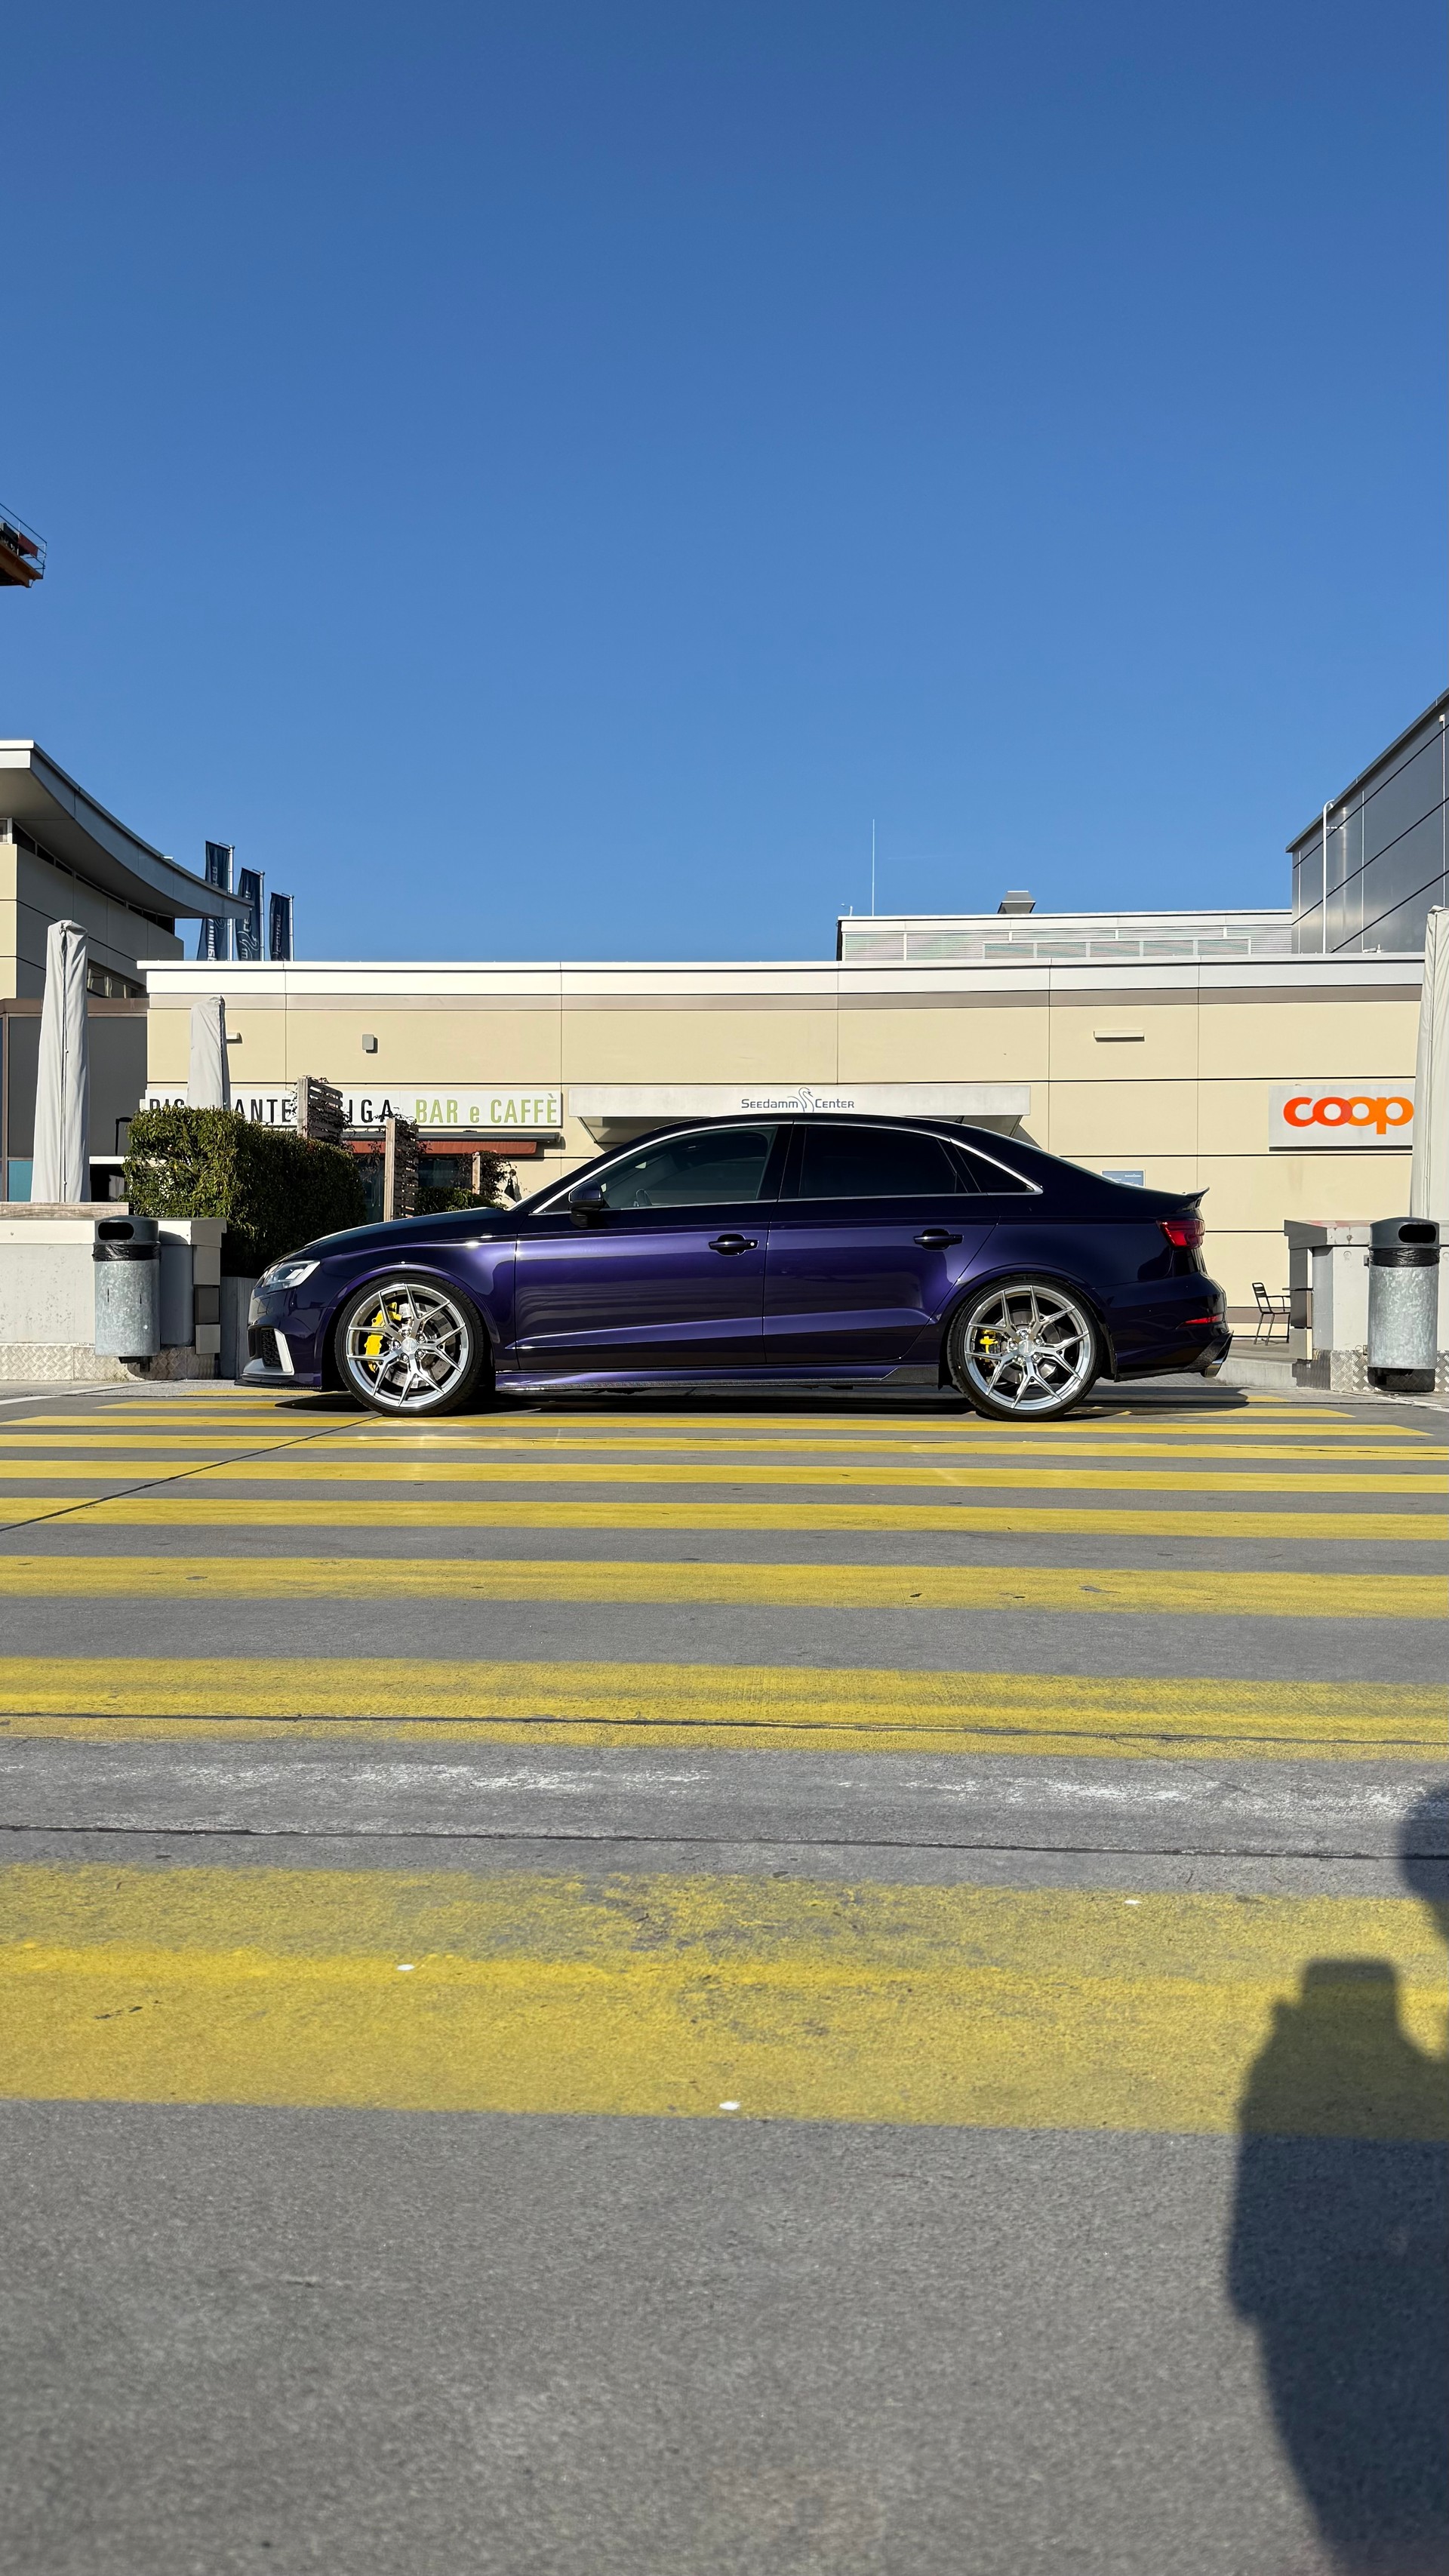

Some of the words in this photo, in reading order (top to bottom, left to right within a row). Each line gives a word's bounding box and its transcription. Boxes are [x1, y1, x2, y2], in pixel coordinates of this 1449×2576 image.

[416, 1099, 458, 1123] BAR
[469, 1106, 480, 1123] e
[491, 1093, 557, 1123] CAFFÈ
[1283, 1096, 1414, 1135] coop
